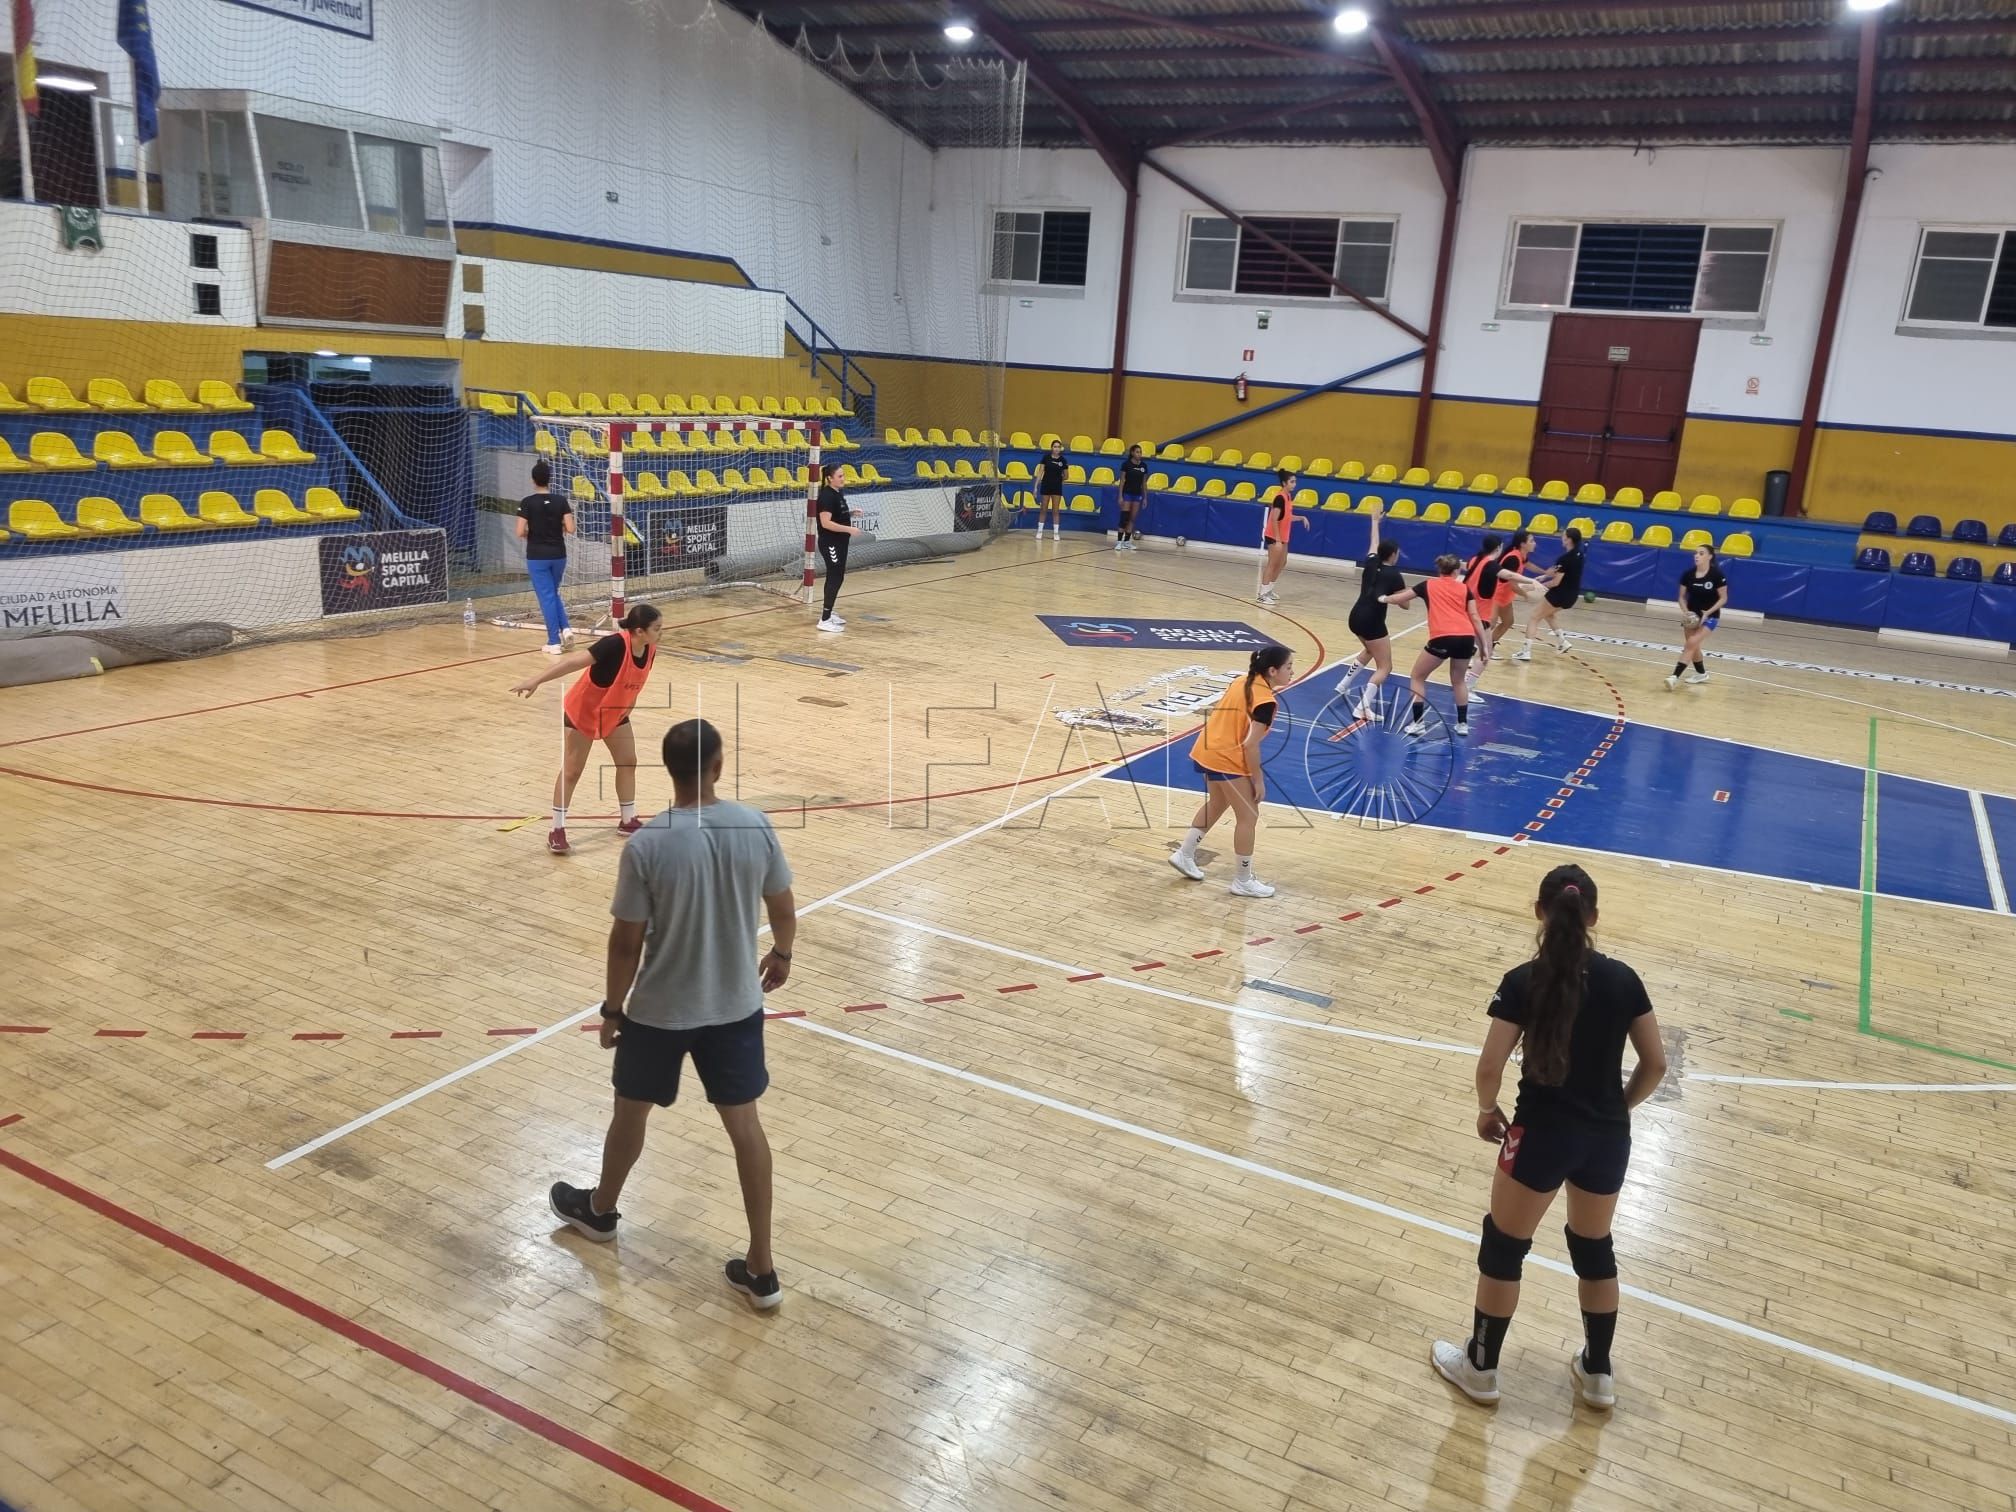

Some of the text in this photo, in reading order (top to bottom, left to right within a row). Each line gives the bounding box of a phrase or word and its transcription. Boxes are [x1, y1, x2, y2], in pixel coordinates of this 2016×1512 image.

[687, 523, 717, 534] MELILLA
[687, 533, 711, 544] SPORT
[687, 542, 717, 553] CAPITAL
[381, 550, 429, 564] MELILLA
[382, 563, 421, 576] SPORT
[382, 574, 431, 588] CAPITAL
[0, 592, 45, 605] CIUDAD
[3, 600, 122, 628] MELILLA
